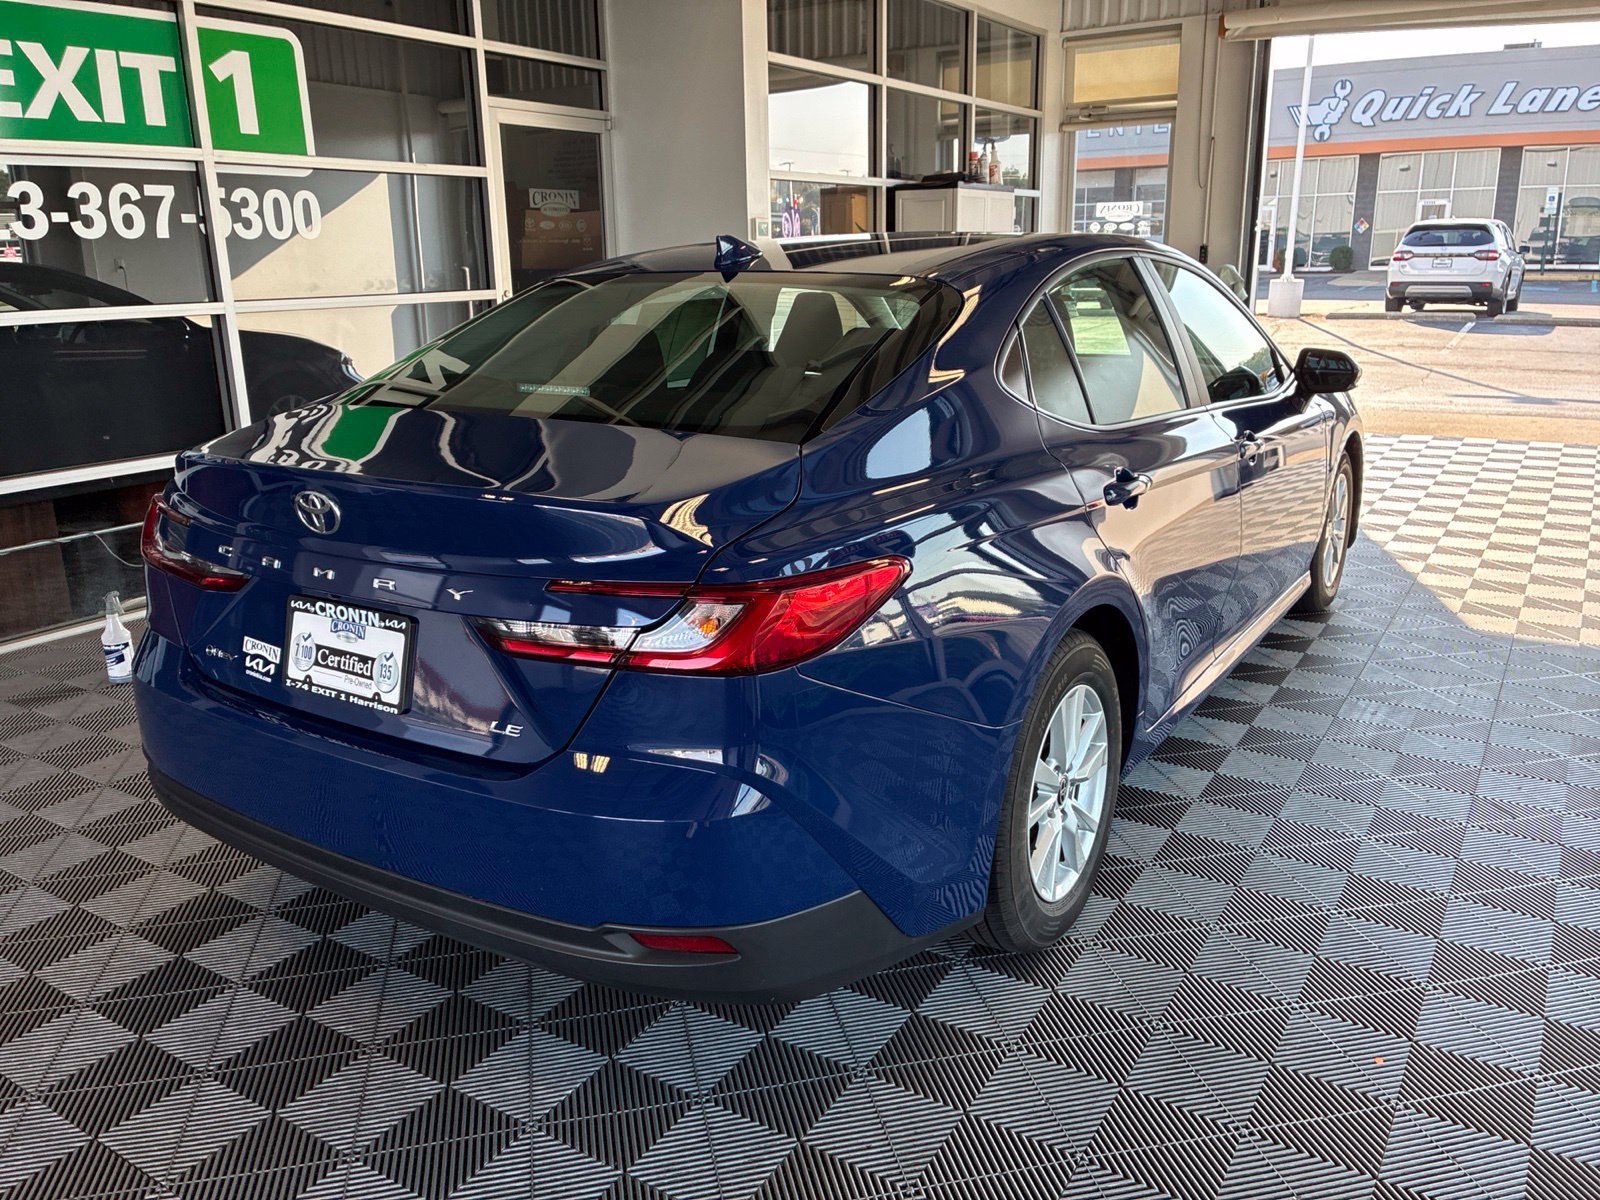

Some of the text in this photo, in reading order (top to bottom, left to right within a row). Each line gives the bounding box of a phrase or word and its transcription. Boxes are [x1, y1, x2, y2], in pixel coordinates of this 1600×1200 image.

[209, 50, 260, 135] 1
[1351, 80, 1600, 128] Quick Lane
[532, 190, 577, 207] CRONIN
[218, 545, 474, 601] CAMRY
[315, 601, 380, 628] CRONIN
[331, 619, 366, 639] CRONIN
[245, 638, 279, 661] CRONIN
[317, 648, 372, 677] Certified
[379, 663, 393, 681] 135
[344, 674, 373, 690] Pre-Owned
[285, 679, 399, 715] I-74 EXIT 1 Harrison
[489, 720, 524, 738] LE
